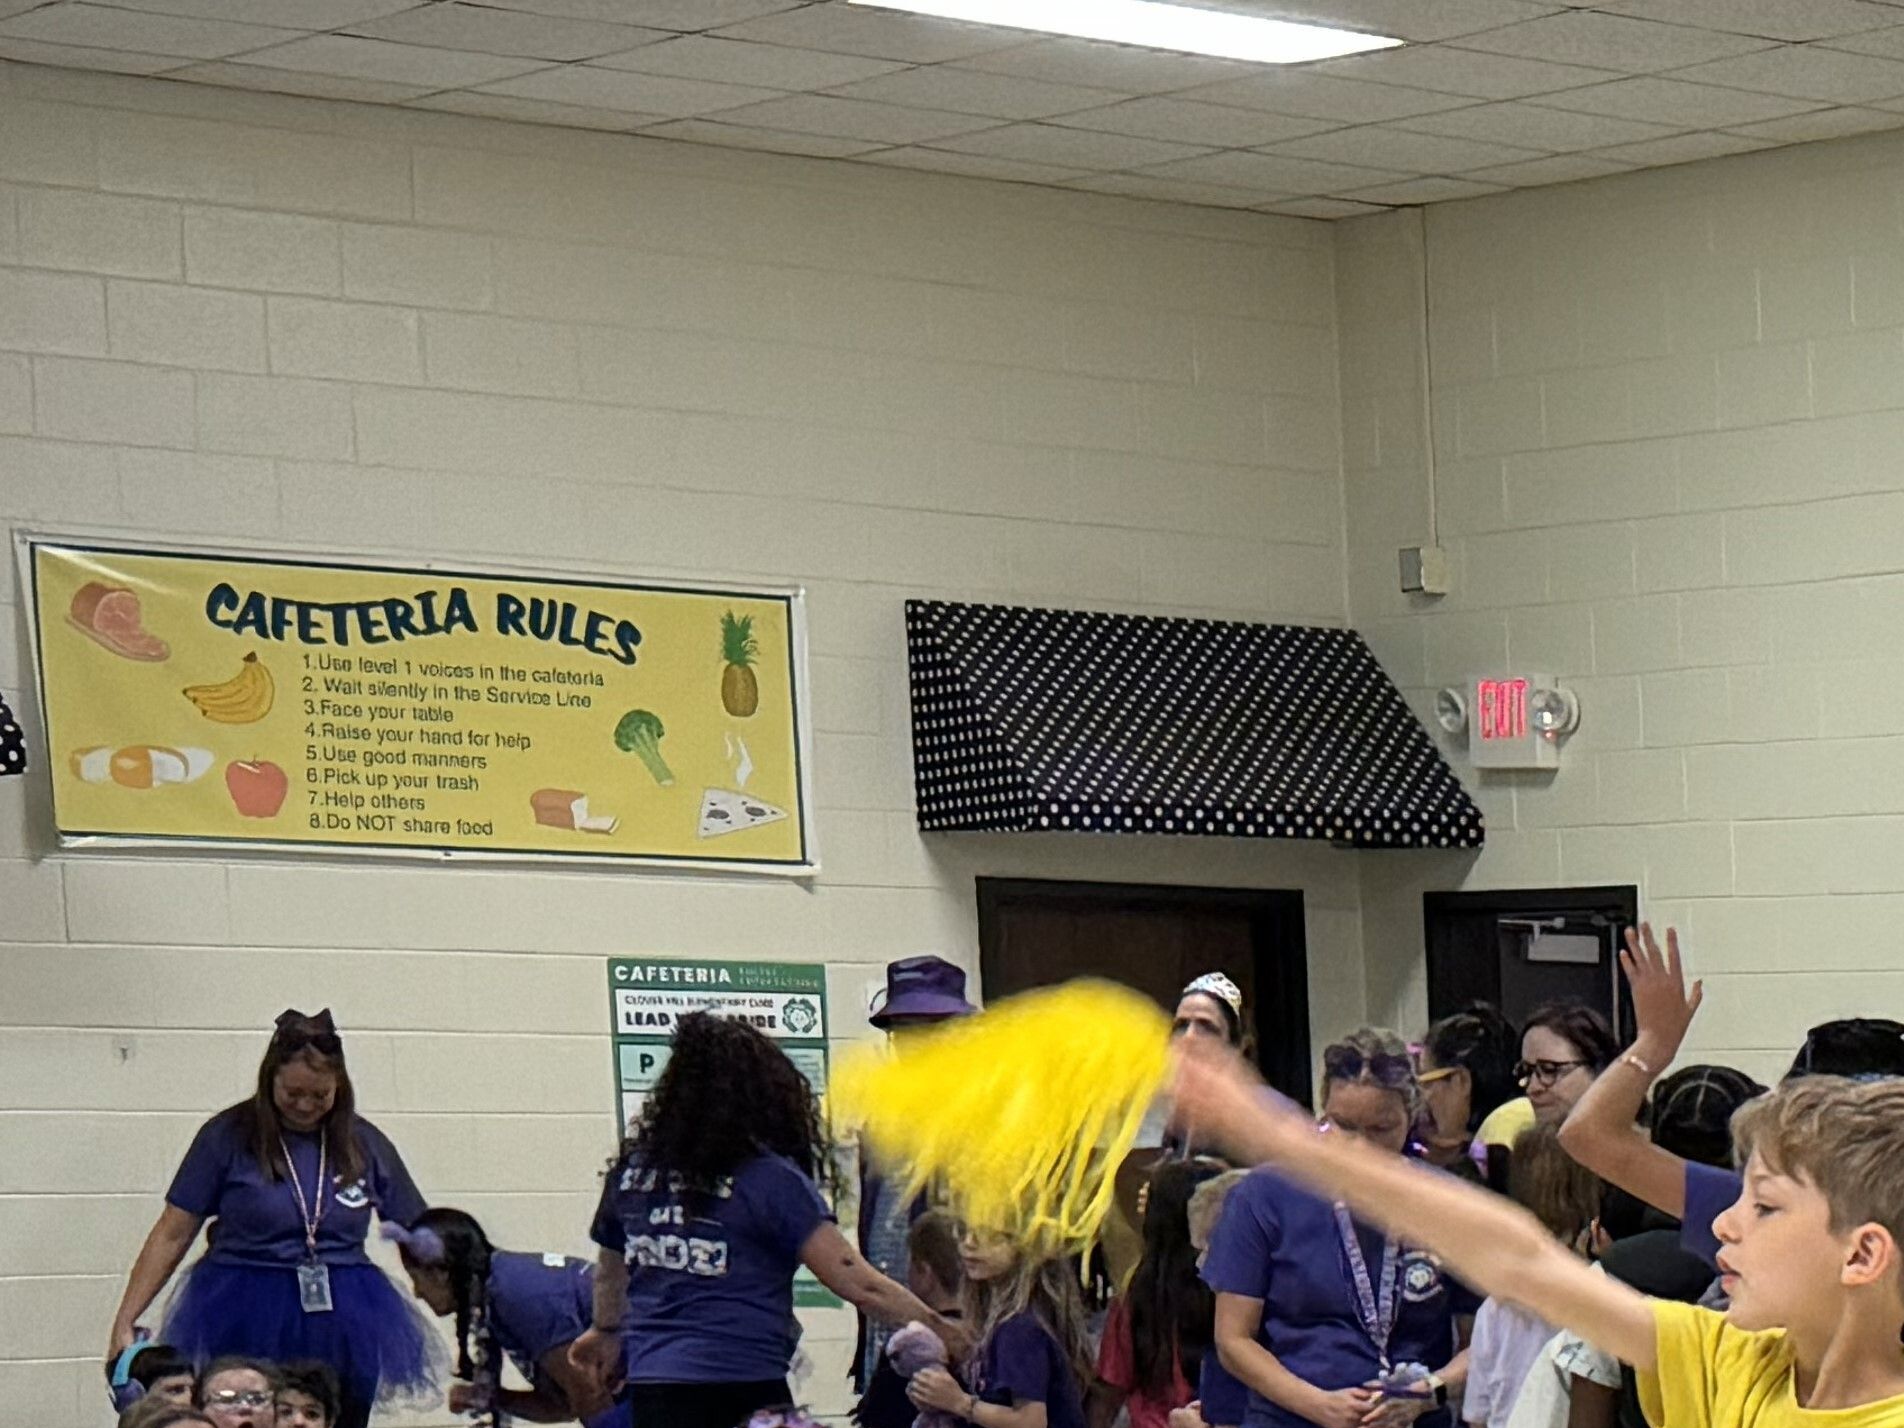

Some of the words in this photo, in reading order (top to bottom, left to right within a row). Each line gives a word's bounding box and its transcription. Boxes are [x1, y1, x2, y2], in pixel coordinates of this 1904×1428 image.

[206, 582, 479, 647] CAFETERIA
[497, 593, 642, 665] RULES
[359, 657, 397, 674] level
[405, 661, 411, 674] 1
[419, 661, 474, 679] voices
[480, 664, 494, 680] in
[500, 665, 526, 682] the
[532, 667, 604, 687] cafeteria
[302, 676, 318, 692] 2.
[324, 678, 362, 695] Wait
[368, 681, 428, 702] silently
[434, 685, 448, 700] in
[454, 685, 481, 701] the
[487, 686, 551, 706] Service
[557, 690, 592, 708] Line
[368, 706, 405, 722] your
[413, 706, 454, 722] table
[1479, 681, 1528, 739] EXIT
[377, 728, 413, 745] your
[420, 728, 463, 746] hand
[468, 730, 490, 747] for
[496, 732, 531, 751] help
[363, 750, 406, 767] good
[412, 752, 487, 769] manners
[366, 773, 388, 789] up
[393, 775, 428, 791] your
[437, 774, 479, 792] trash
[371, 793, 425, 811] others
[357, 814, 396, 832] NOT
[403, 817, 450, 835] share
[457, 818, 493, 836] food
[614, 965, 732, 984] CAFETERIA
[625, 1012, 670, 1026] LEAD
